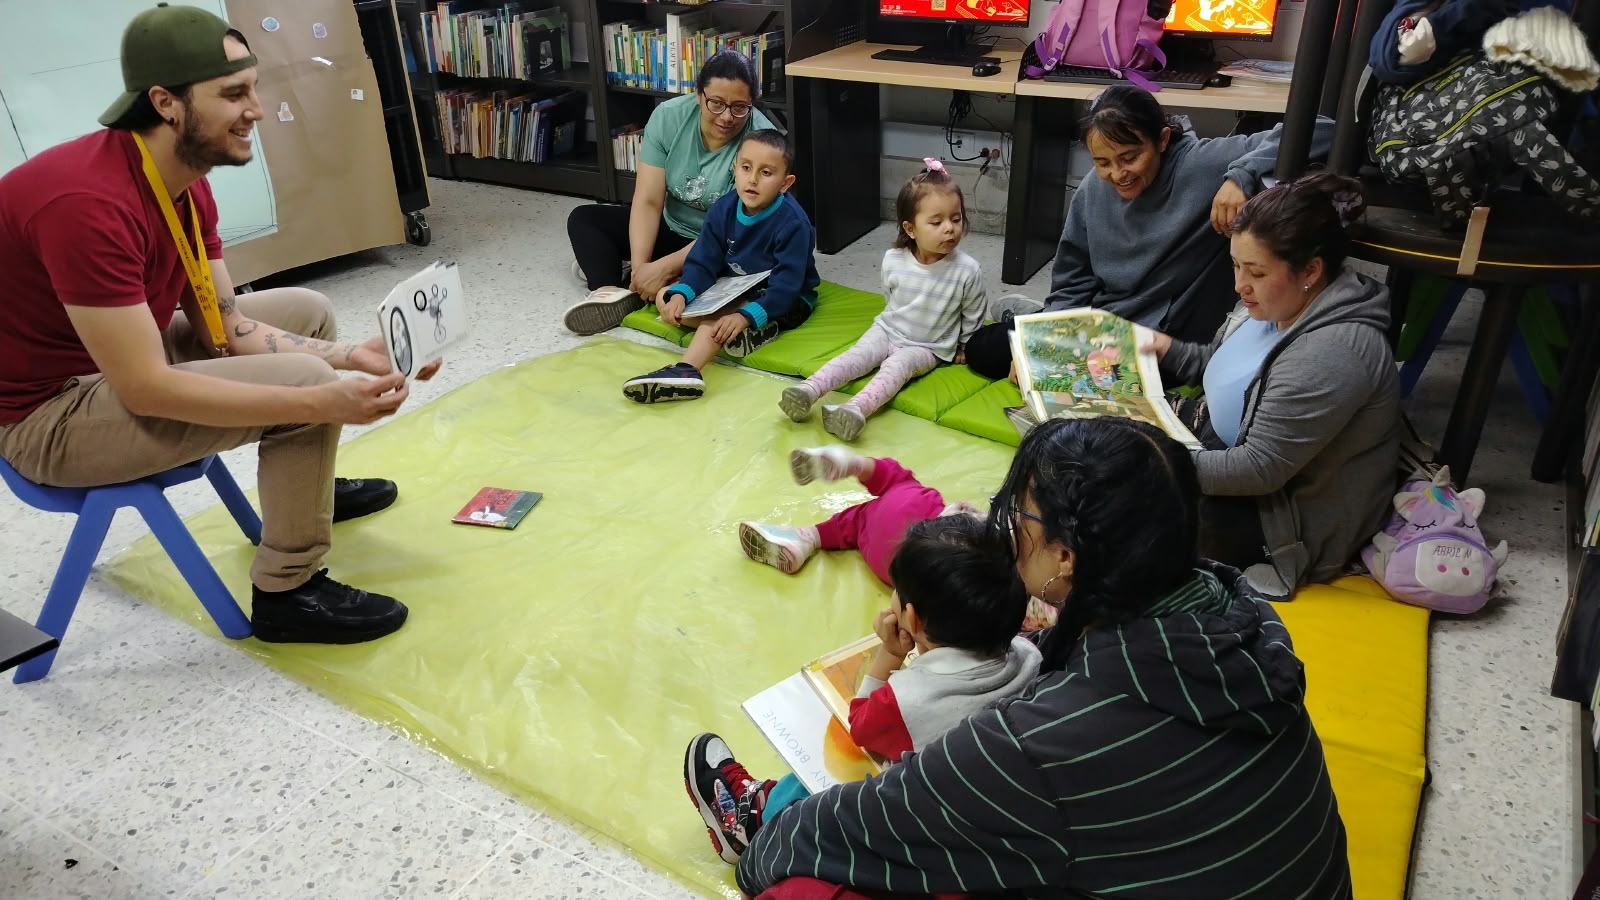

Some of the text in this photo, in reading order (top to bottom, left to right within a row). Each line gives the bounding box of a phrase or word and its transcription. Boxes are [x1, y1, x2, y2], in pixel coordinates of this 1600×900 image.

[669, 41, 677, 69] ALICIA
[762, 710, 832, 789] NY BROWNE
